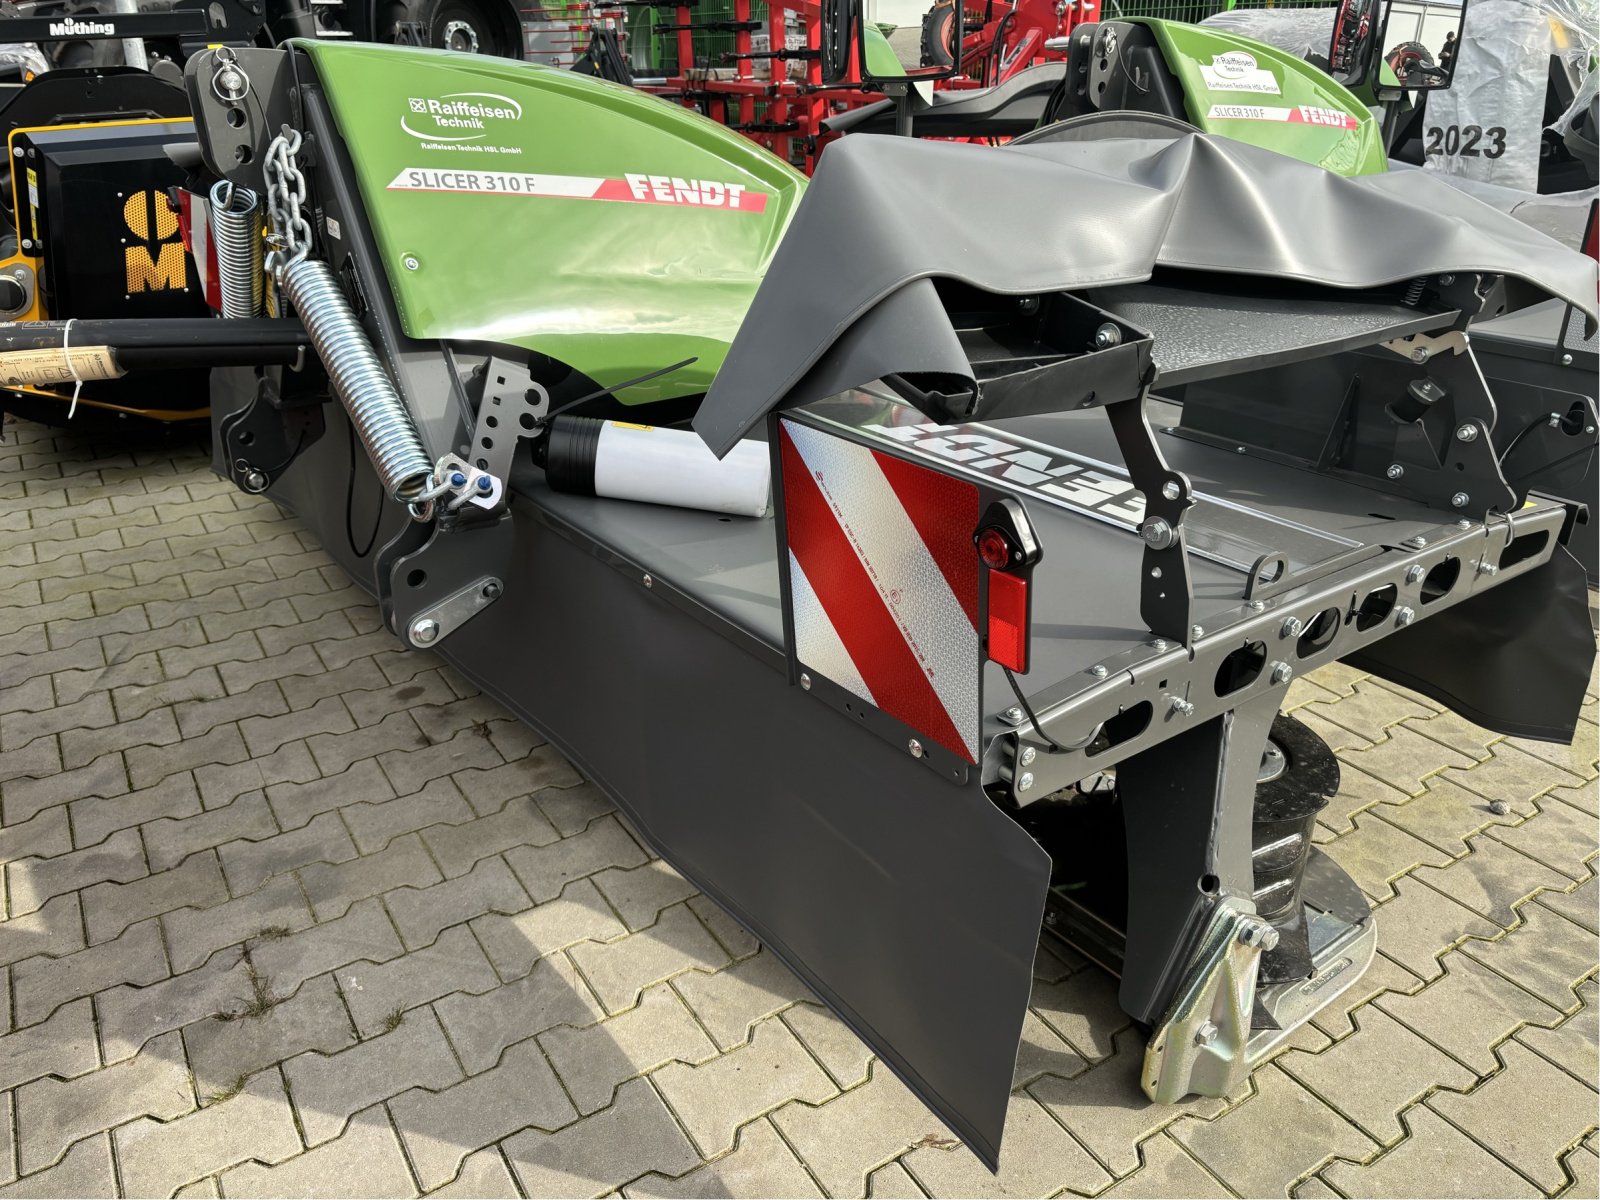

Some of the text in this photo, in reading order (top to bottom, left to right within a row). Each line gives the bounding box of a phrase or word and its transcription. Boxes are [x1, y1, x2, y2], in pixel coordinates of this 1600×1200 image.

[1221, 56, 1255, 67] Raiffeisen
[1225, 65, 1245, 73] Technik
[427, 99, 516, 120] Raiffeisen
[1214, 107, 1265, 119] SLICER 310 F
[1298, 105, 1347, 127] FENDT
[432, 115, 485, 129] Technik
[420, 142, 522, 154] Raiffeisen Technik HSL GmbH
[1426, 124, 1507, 160] 2023
[409, 171, 536, 192] SLICER 310 F
[624, 173, 746, 208] FENDT
